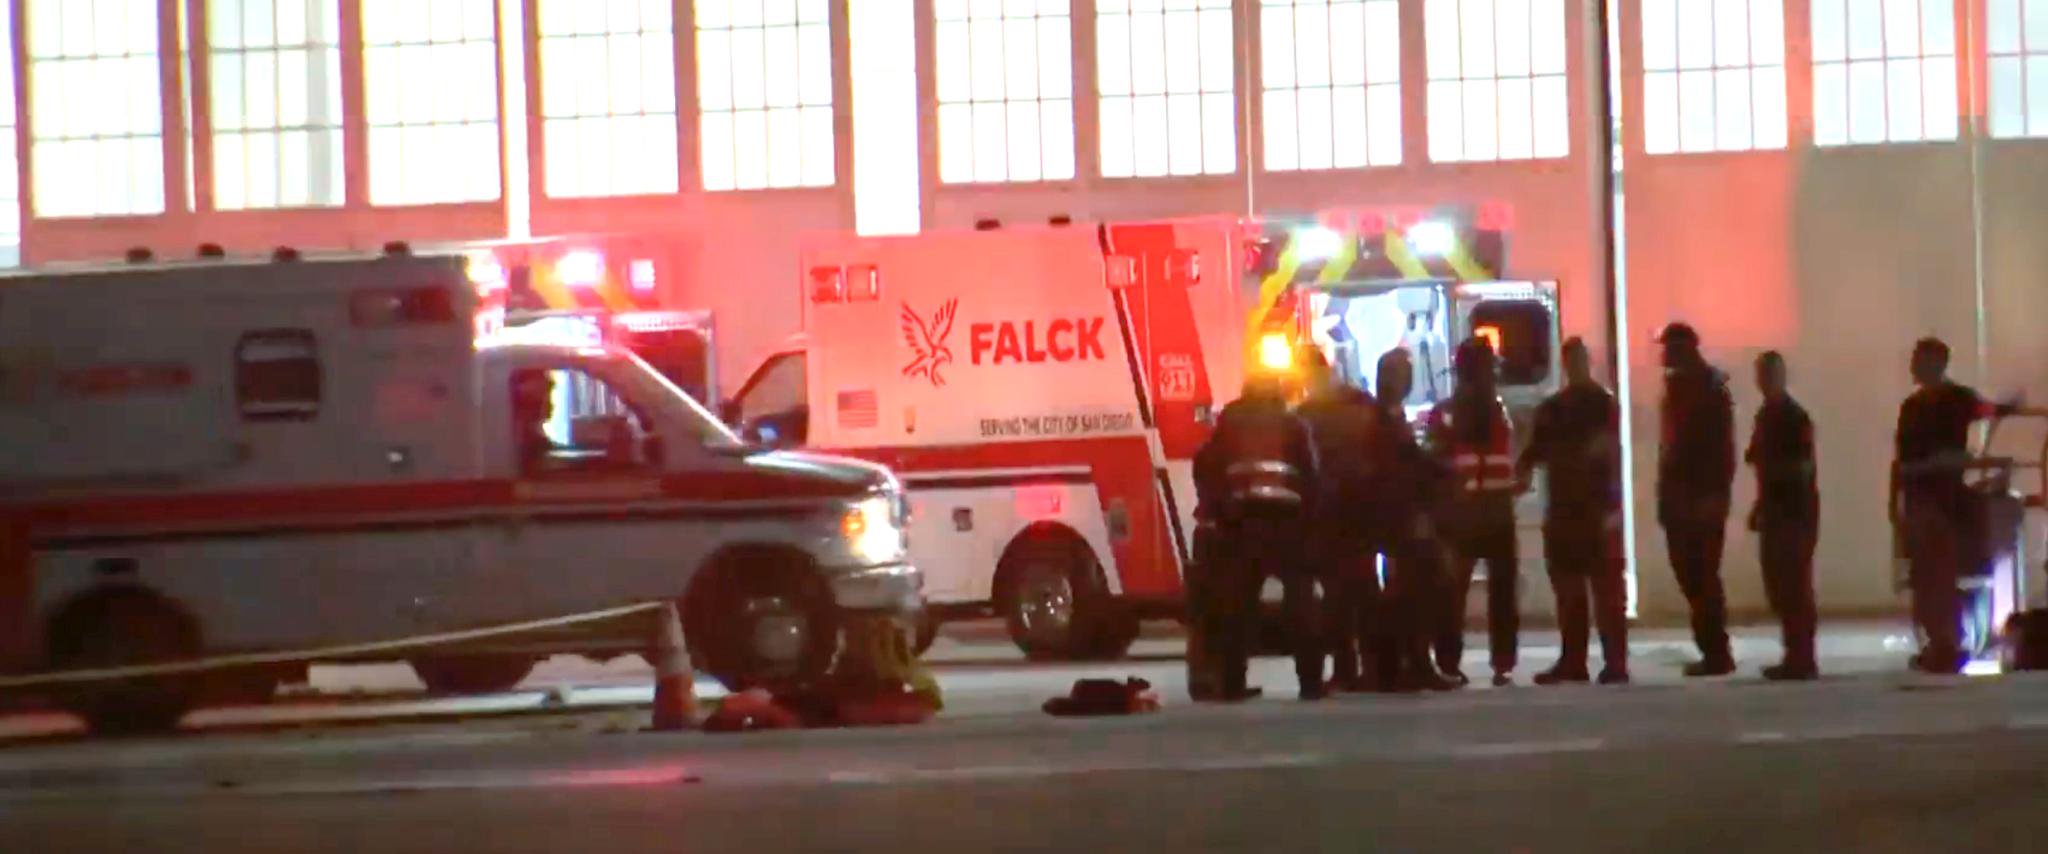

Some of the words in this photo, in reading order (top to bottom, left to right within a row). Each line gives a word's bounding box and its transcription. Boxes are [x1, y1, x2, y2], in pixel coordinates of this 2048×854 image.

[970, 316, 1105, 366] FALCK
[980, 417, 1021, 437] SERVING
[1022, 416, 1040, 435] THE
[1043, 415, 1063, 435] CITY
[1066, 414, 1078, 433] OF
[1081, 413, 1101, 432] SAN
[1102, 412, 1134, 431] DIEGO
